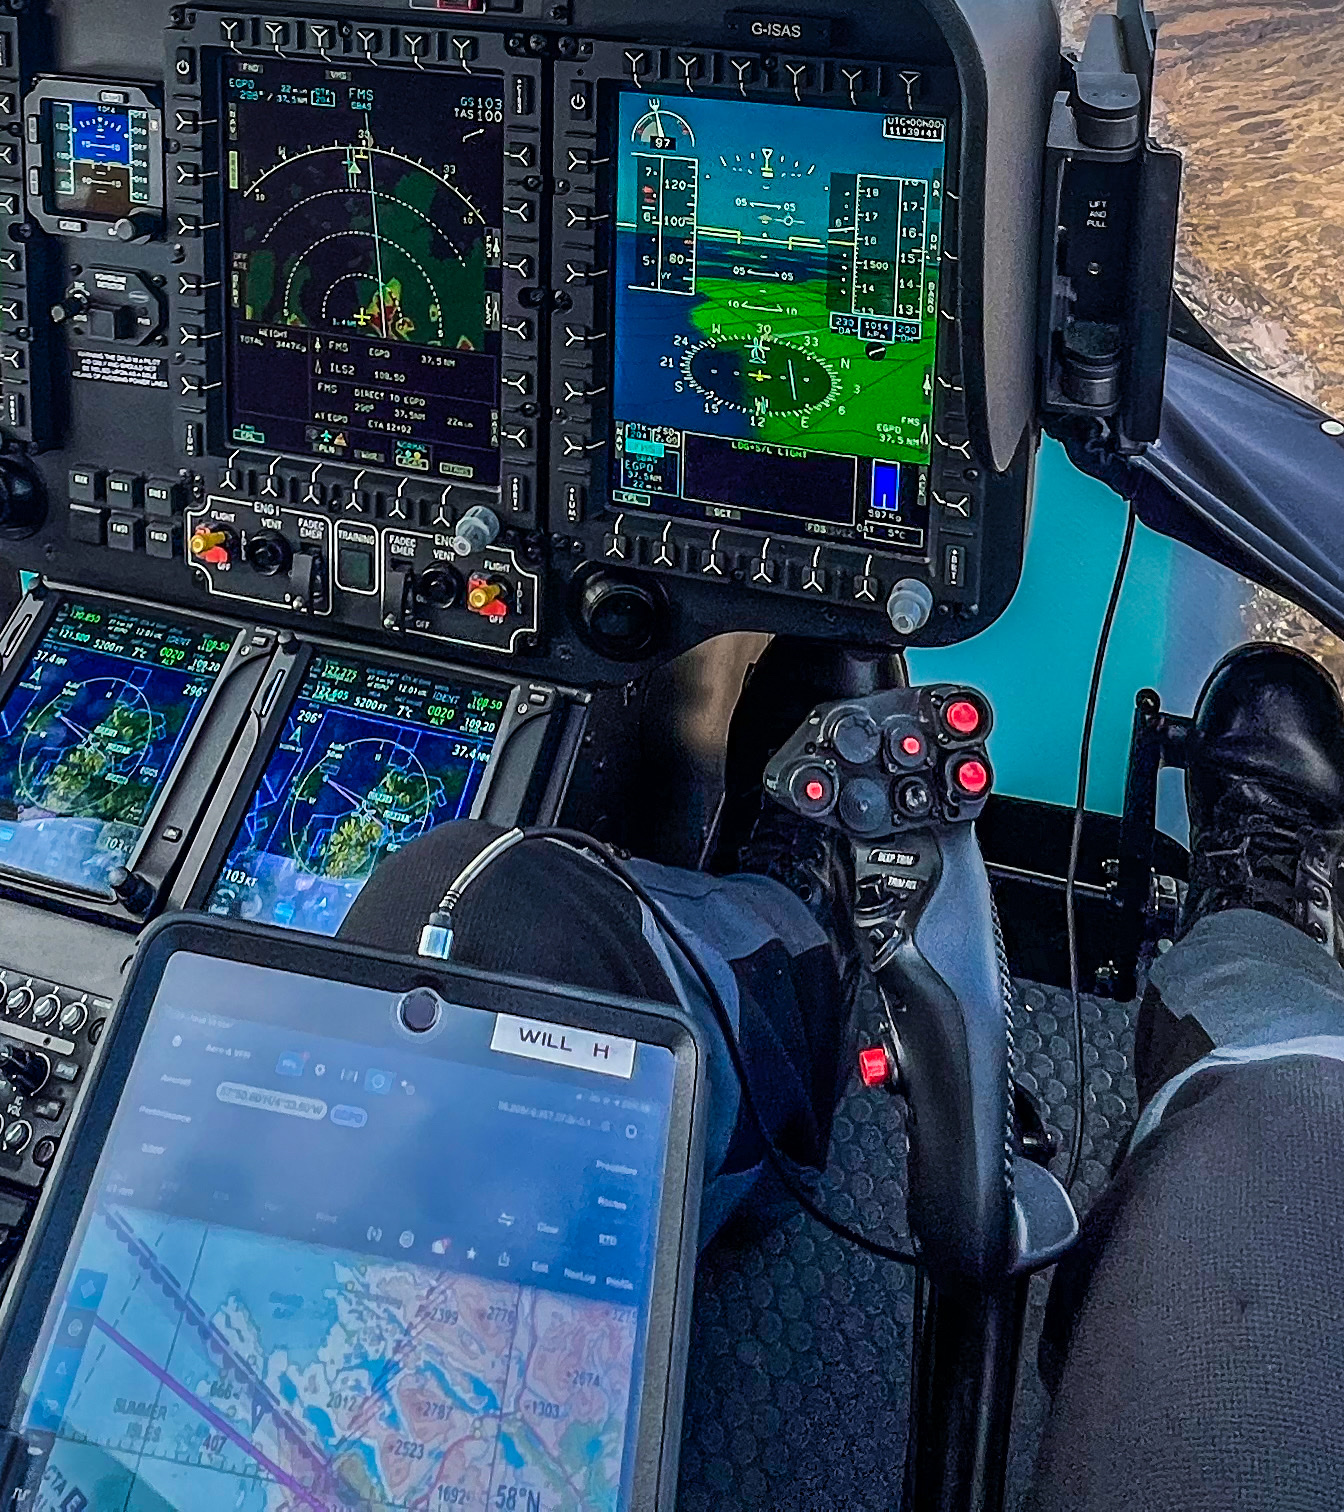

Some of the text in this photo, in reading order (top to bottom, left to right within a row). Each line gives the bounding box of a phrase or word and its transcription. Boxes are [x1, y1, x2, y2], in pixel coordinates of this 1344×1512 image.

[751, 22, 801, 37] G-ISAS
[348, 87, 374, 102] FMS
[460, 96, 503, 110] GS 103
[454, 107, 503, 123] TAS 100
[889, 126, 938, 138] 11:39:41
[655, 137, 670, 148] 97
[443, 164, 456, 175] 33
[664, 178, 687, 190] 120
[865, 187, 879, 198] 18
[735, 197, 748, 207] 05
[783, 202, 796, 212] 05
[902, 201, 918, 212] 17
[1088, 200, 1107, 208] LIFT
[864, 212, 879, 222] 17
[1089, 210, 1107, 218] AND
[662, 215, 687, 228] 100
[1086, 219, 1107, 228] PULL
[901, 227, 917, 238] 16
[668, 253, 685, 266] 80
[900, 252, 916, 264] 15
[732, 265, 746, 275] 05
[863, 259, 889, 271] 1500
[781, 271, 794, 281] 05
[862, 283, 875, 294] 14
[899, 278, 914, 289] 14
[728, 299, 739, 309] 10
[927, 281, 936, 314] BARO
[785, 307, 798, 316] 10
[898, 303, 914, 316] 13
[711, 323, 721, 334] W
[835, 317, 854, 327] 230
[864, 321, 889, 331] 1014
[756, 323, 772, 335] 30
[328, 340, 349, 353] FMS
[673, 334, 689, 347] 24
[803, 334, 819, 347] 33
[659, 355, 674, 368] 21
[840, 357, 850, 370] N
[329, 362, 355, 376] ILS2
[317, 382, 338, 394] FMS
[674, 380, 684, 393] S
[854, 383, 861, 394] 3
[354, 388, 385, 401] DIRECT
[704, 402, 719, 414] 15
[837, 405, 845, 416] 6
[750, 415, 766, 428] 12
[800, 416, 809, 429] E
[901, 416, 920, 427] FMS
[879, 433, 905, 445] 37.5
[777, 447, 807, 459] LIGHT
[624, 459, 654, 473] EGPO
[253, 499, 275, 515] ENG
[210, 510, 236, 523] FLIGHT
[261, 517, 282, 530] VENT
[298, 517, 325, 531] FADEC
[856, 524, 874, 534] OAT
[299, 527, 323, 540] EMER
[338, 529, 375, 545] TRAINING
[388, 535, 416, 548] FADEC
[390, 544, 415, 557] EMER
[432, 549, 456, 562] VENT
[483, 560, 511, 573] FLIGHT
[159, 646, 185, 660] 0020
[182, 683, 208, 698] 296°
[432, 690, 461, 704] IDENT
[297, 709, 323, 724] 296°
[427, 704, 496, 733] 0020 109.20
[519, 1027, 610, 1060] WILL H
[495, 1486, 541, 1512] 58°N
